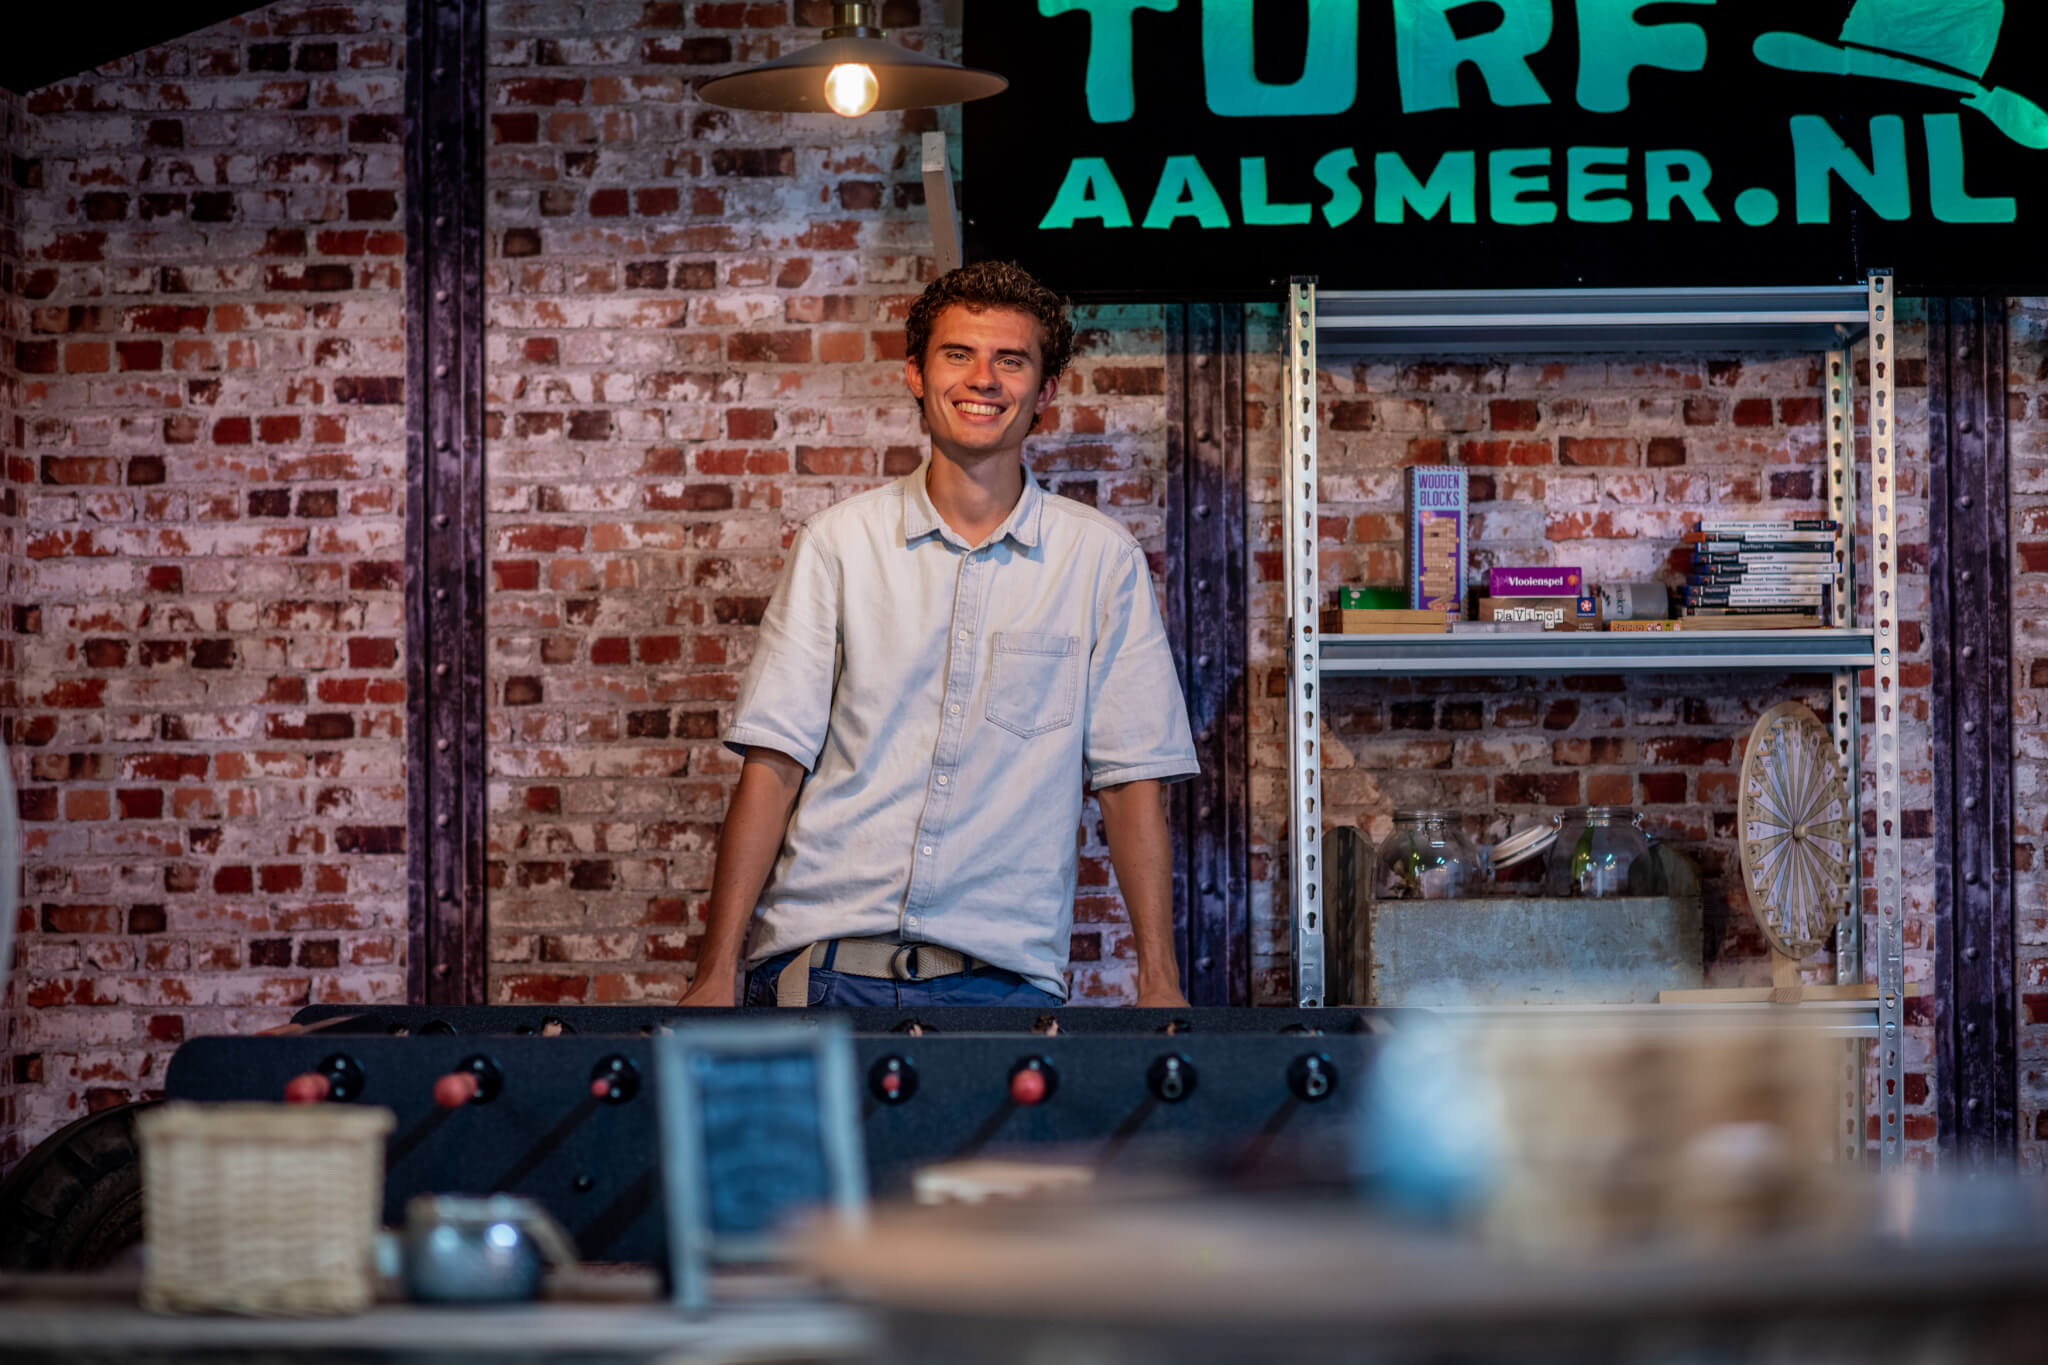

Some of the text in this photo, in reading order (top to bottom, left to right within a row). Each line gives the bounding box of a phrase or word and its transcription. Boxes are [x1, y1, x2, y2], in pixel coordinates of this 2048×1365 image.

[1038, 0, 1717, 123] TURF
[1038, 113, 2017, 230] AALSMEER.NL
[1418, 473, 1460, 489] WOODEN
[1419, 490, 1460, 506] BLOCKS
[1508, 576, 1564, 588] Vlooienspel
